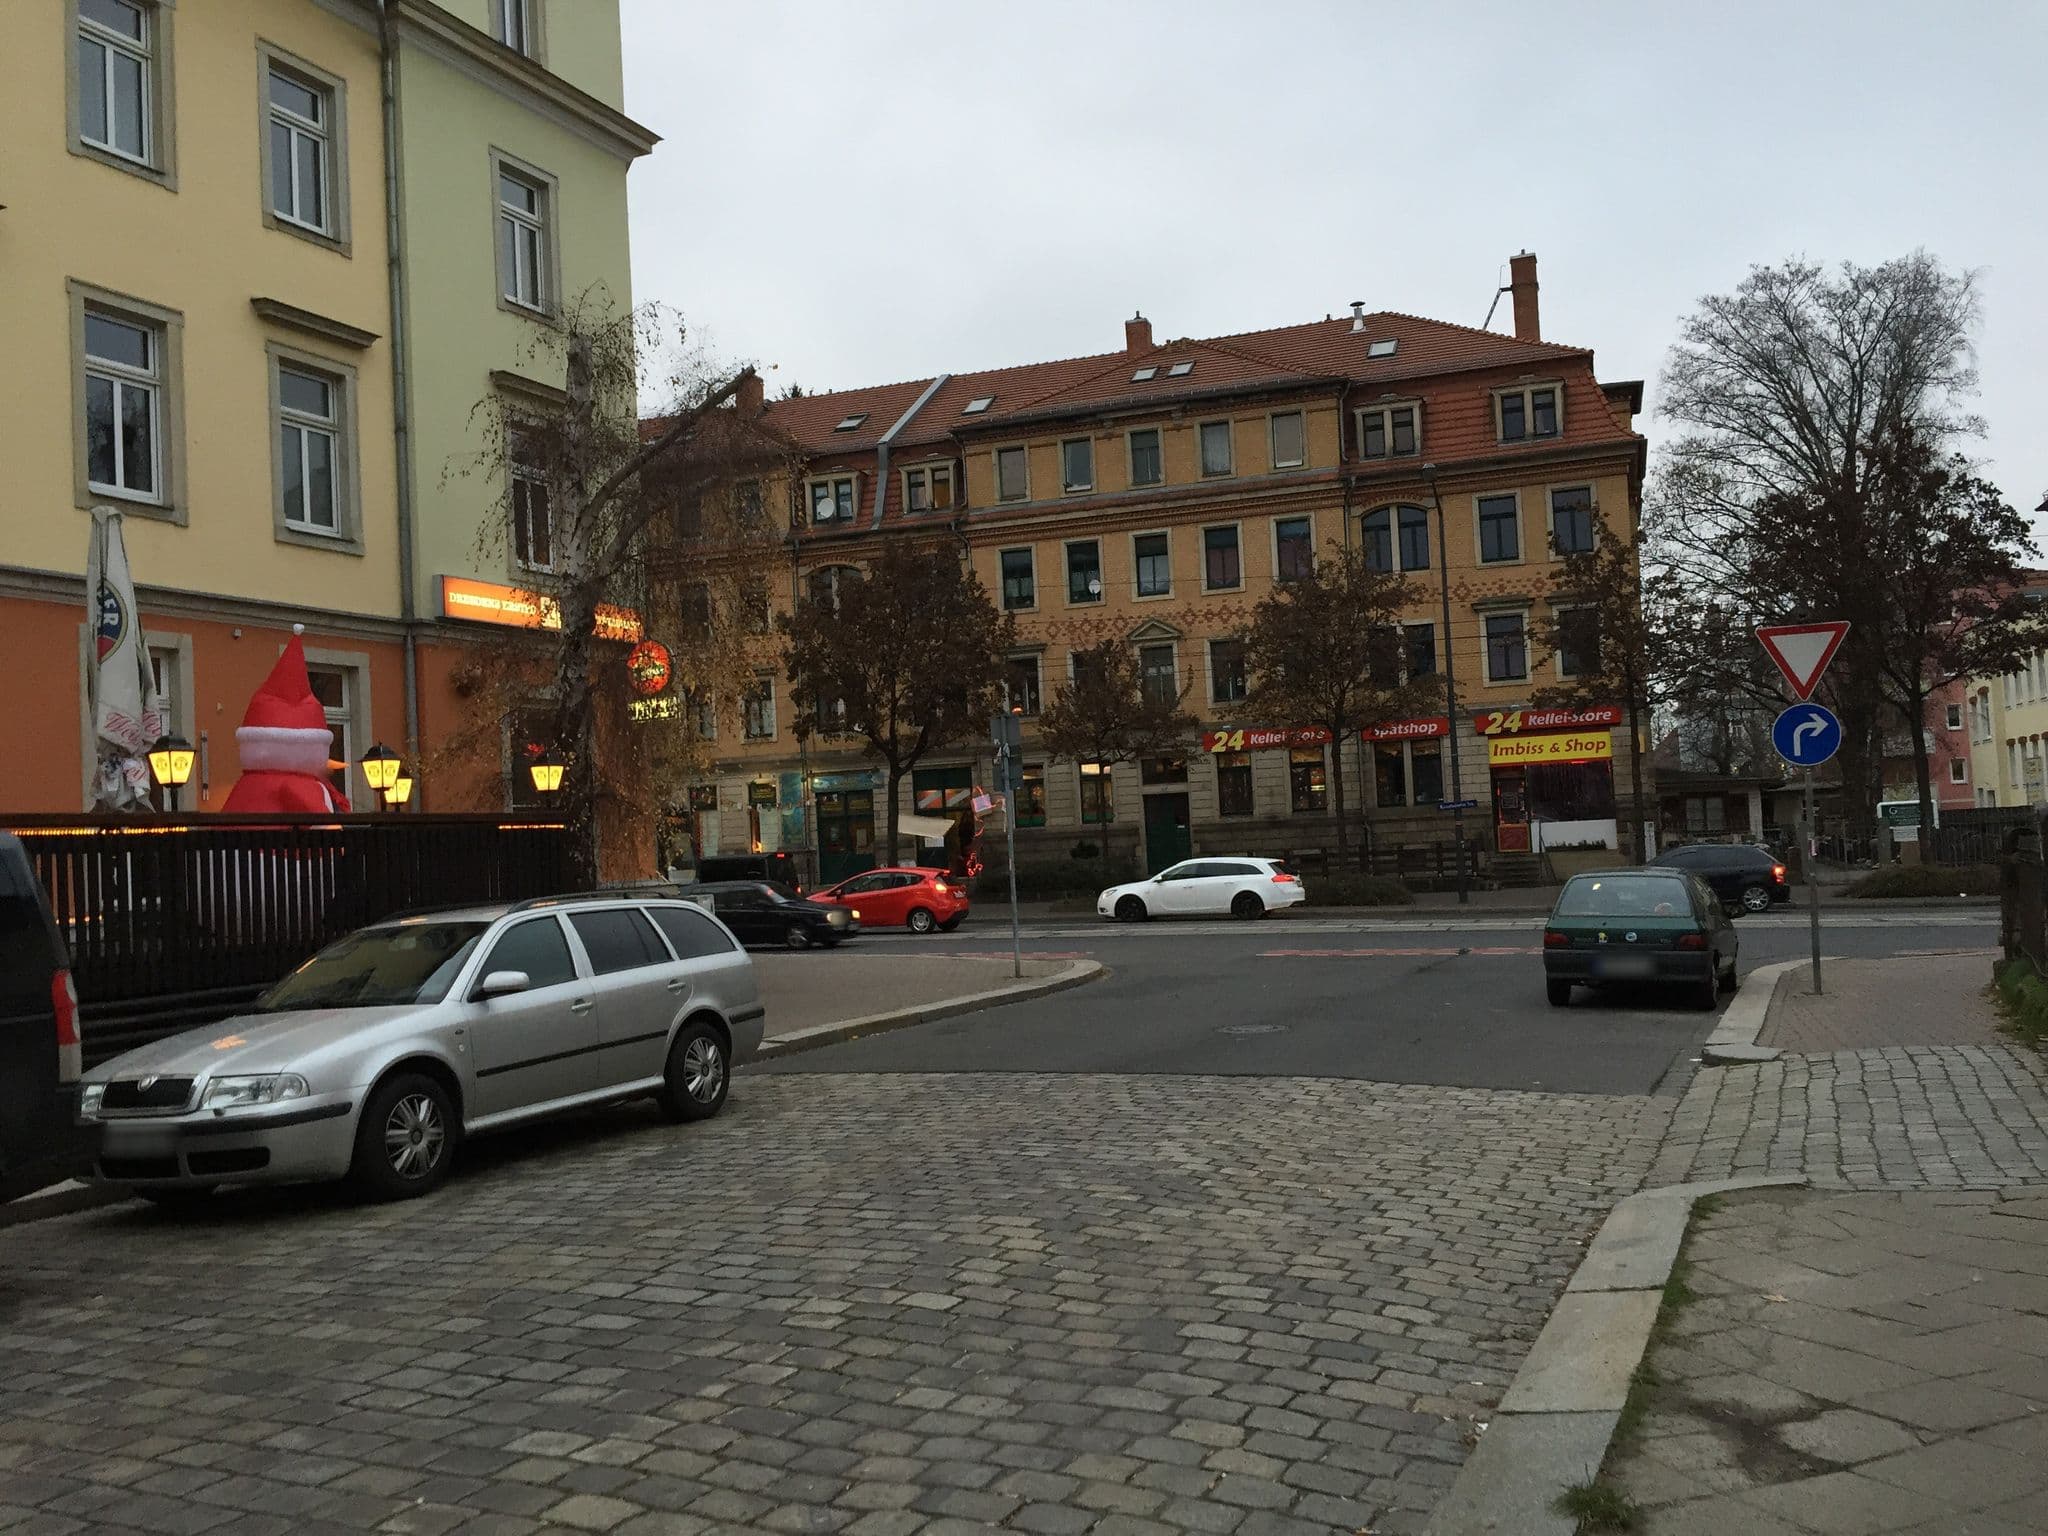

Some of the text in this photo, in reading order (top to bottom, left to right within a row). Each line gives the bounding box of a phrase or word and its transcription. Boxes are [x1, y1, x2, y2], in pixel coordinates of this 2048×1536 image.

[1485, 711, 1522, 734] 24
[1211, 730, 1245, 752] 24
[1493, 739, 1606, 756] Imbiss & Shop
